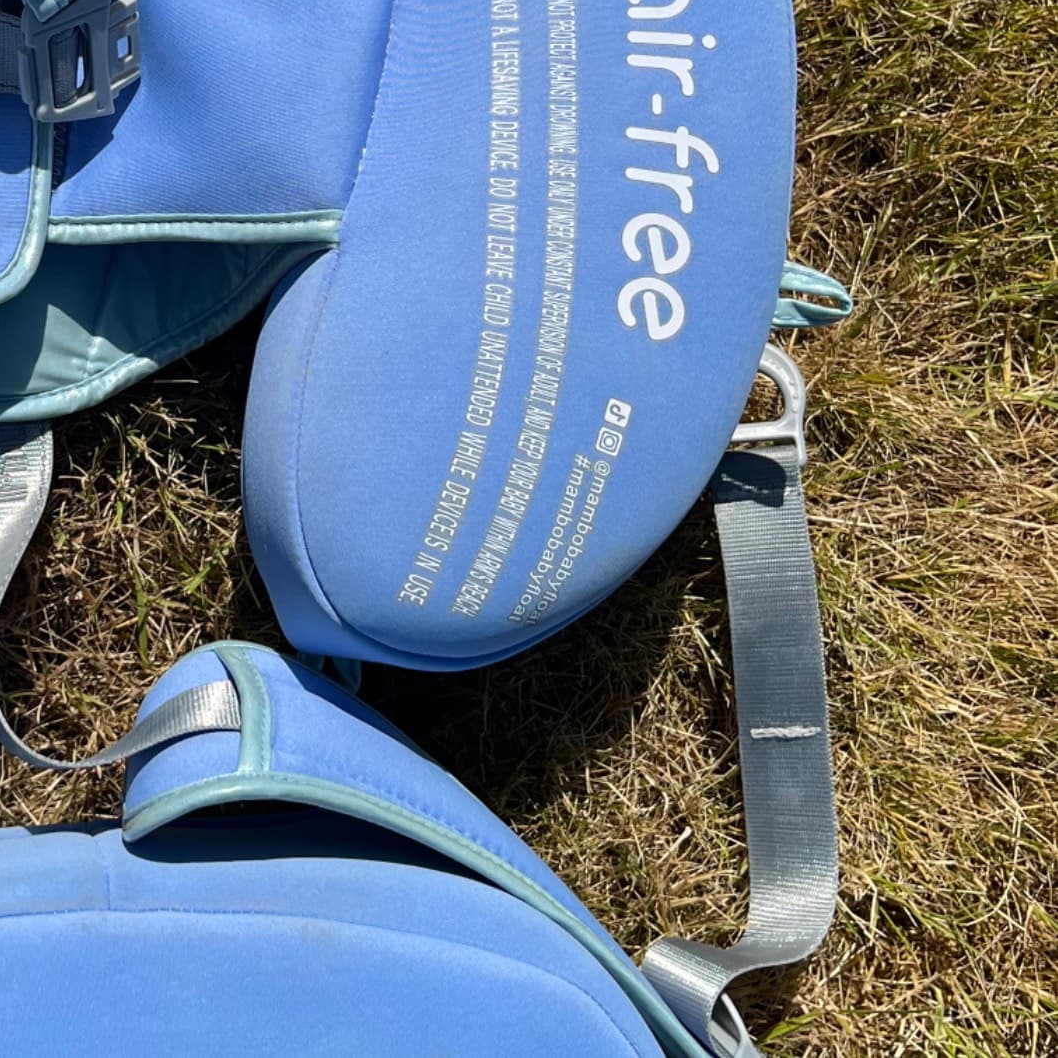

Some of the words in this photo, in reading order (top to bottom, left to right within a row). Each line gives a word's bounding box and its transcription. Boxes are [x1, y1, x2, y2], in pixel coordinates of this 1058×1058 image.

[490, 26, 519, 38] A
[548, 19, 576, 61] PROTECT
[490, 40, 520, 116] LIFESAVING
[549, 62, 577, 102] AGAINST
[548, 159, 576, 178] USE
[489, 177, 517, 198] DO
[547, 180, 575, 205] ONLY
[487, 202, 516, 233] NOT
[546, 206, 575, 238] UNDER
[485, 235, 515, 279] LEAVE
[544, 240, 574, 291] CONSTANT
[483, 283, 512, 326] CHILD
[538, 290, 571, 356] SUPERVISION
[466, 330, 509, 427] UNATTENDED
[535, 355, 563, 373] OF
[524, 404, 553, 430] AND
[450, 431, 487, 480] WHILE
[517, 427, 549, 460] KEEP
[507, 457, 540, 490] YOUR
[429, 480, 470, 536] DEVICE
[498, 486, 529, 518] BABY
[424, 533, 451, 552] IS
[483, 514, 519, 555] WITHIN
[414, 551, 442, 573] IN
[397, 573, 434, 606] USE.
